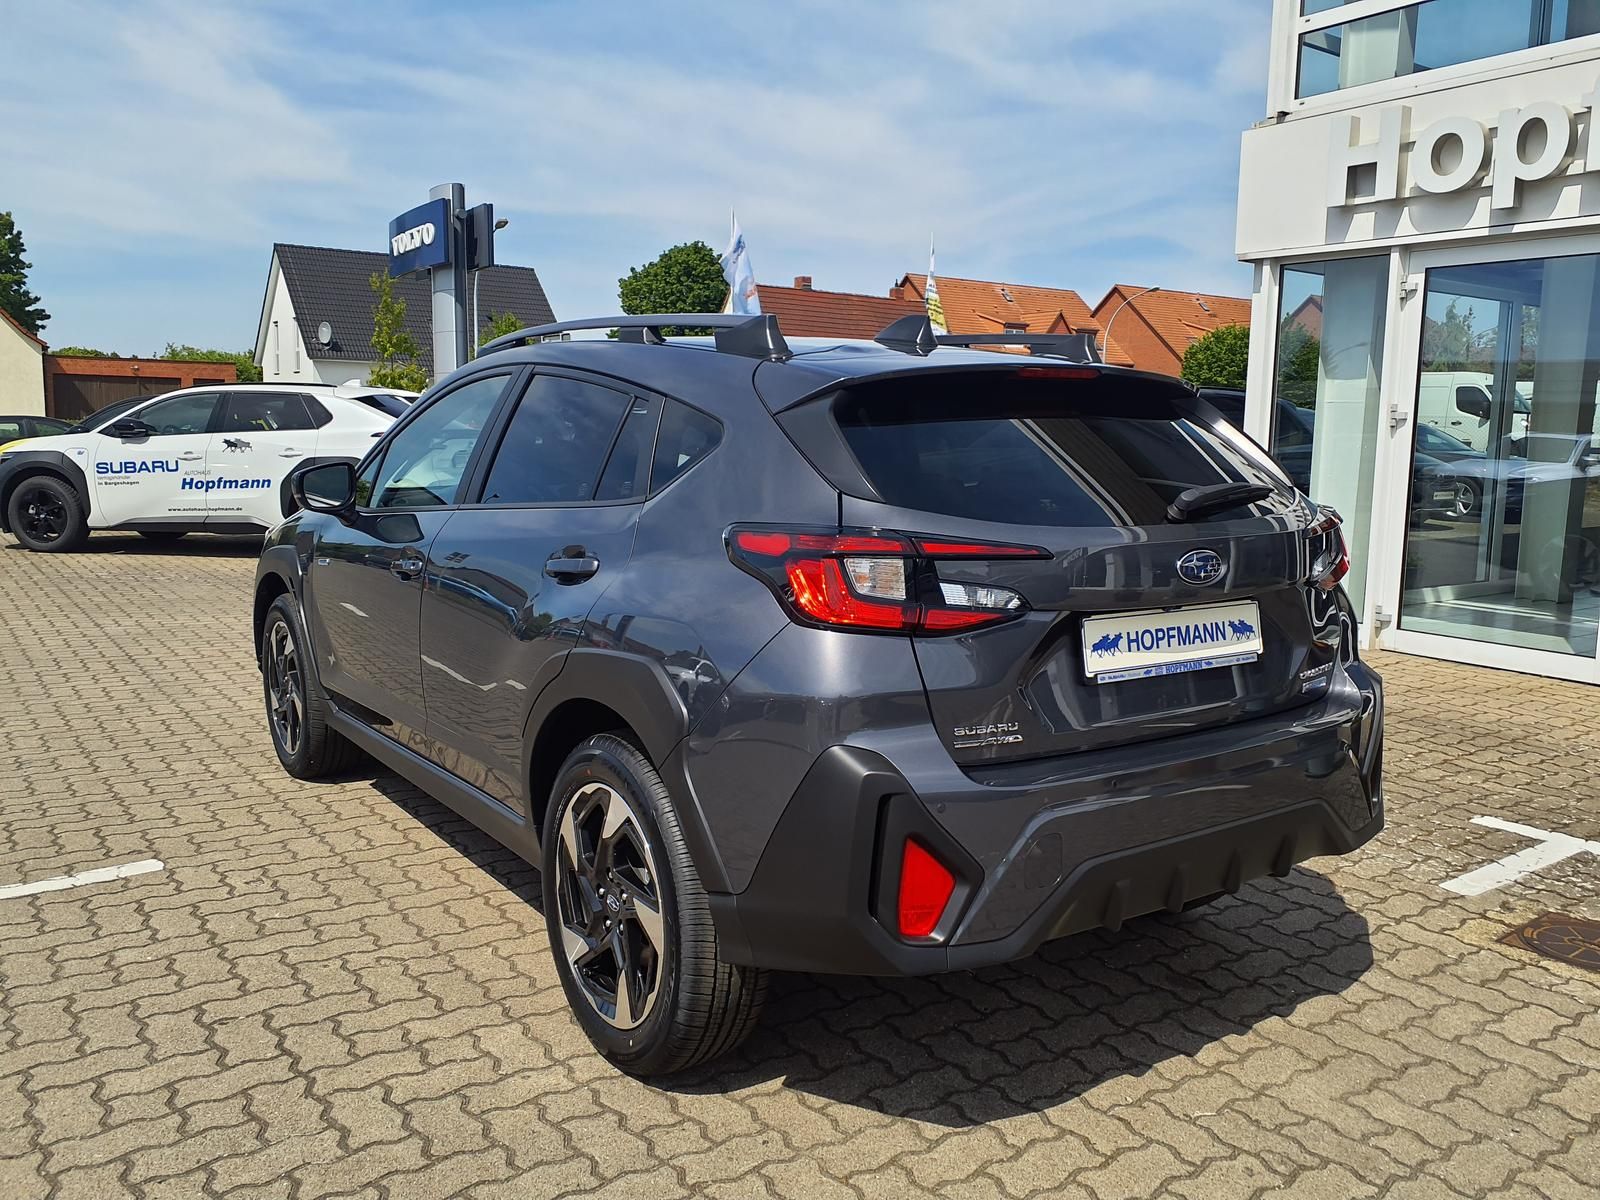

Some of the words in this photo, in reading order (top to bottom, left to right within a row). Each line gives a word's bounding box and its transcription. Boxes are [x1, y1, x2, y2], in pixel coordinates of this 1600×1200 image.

[391, 222, 435, 256] VOLVO
[95, 460, 179, 474] SUBARU
[181, 476, 272, 492] Hopfmann
[1127, 621, 1226, 652] HOPFMANN
[1165, 661, 1203, 674] HOPFMANN
[953, 722, 1019, 736] SUBARU
